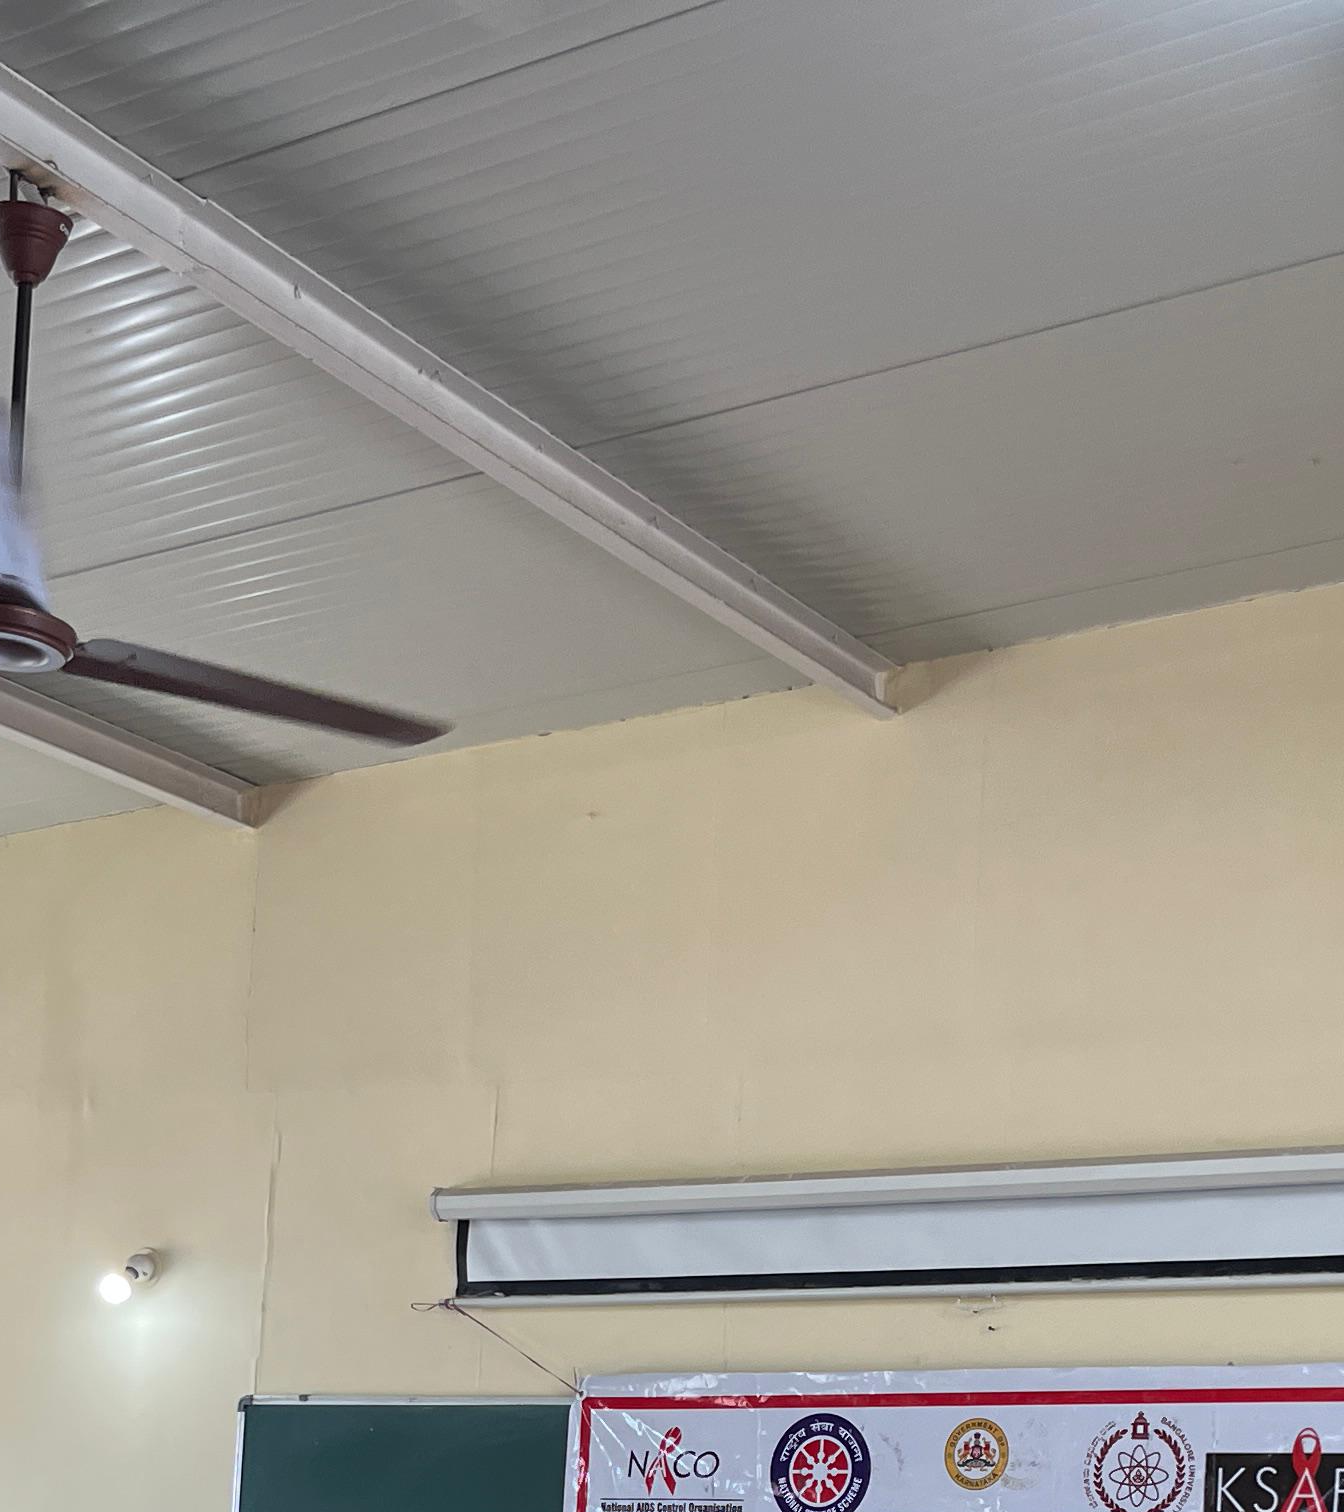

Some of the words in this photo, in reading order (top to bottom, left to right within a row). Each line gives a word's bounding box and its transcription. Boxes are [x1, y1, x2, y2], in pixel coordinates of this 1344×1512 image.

[1160, 1416, 1195, 1462] BANGALORE
[628, 1444, 720, 1496] NACO
[600, 1502, 635, 1512] National
[636, 1502, 655, 1512] AIDS
[837, 1476, 863, 1512] SCHEME
